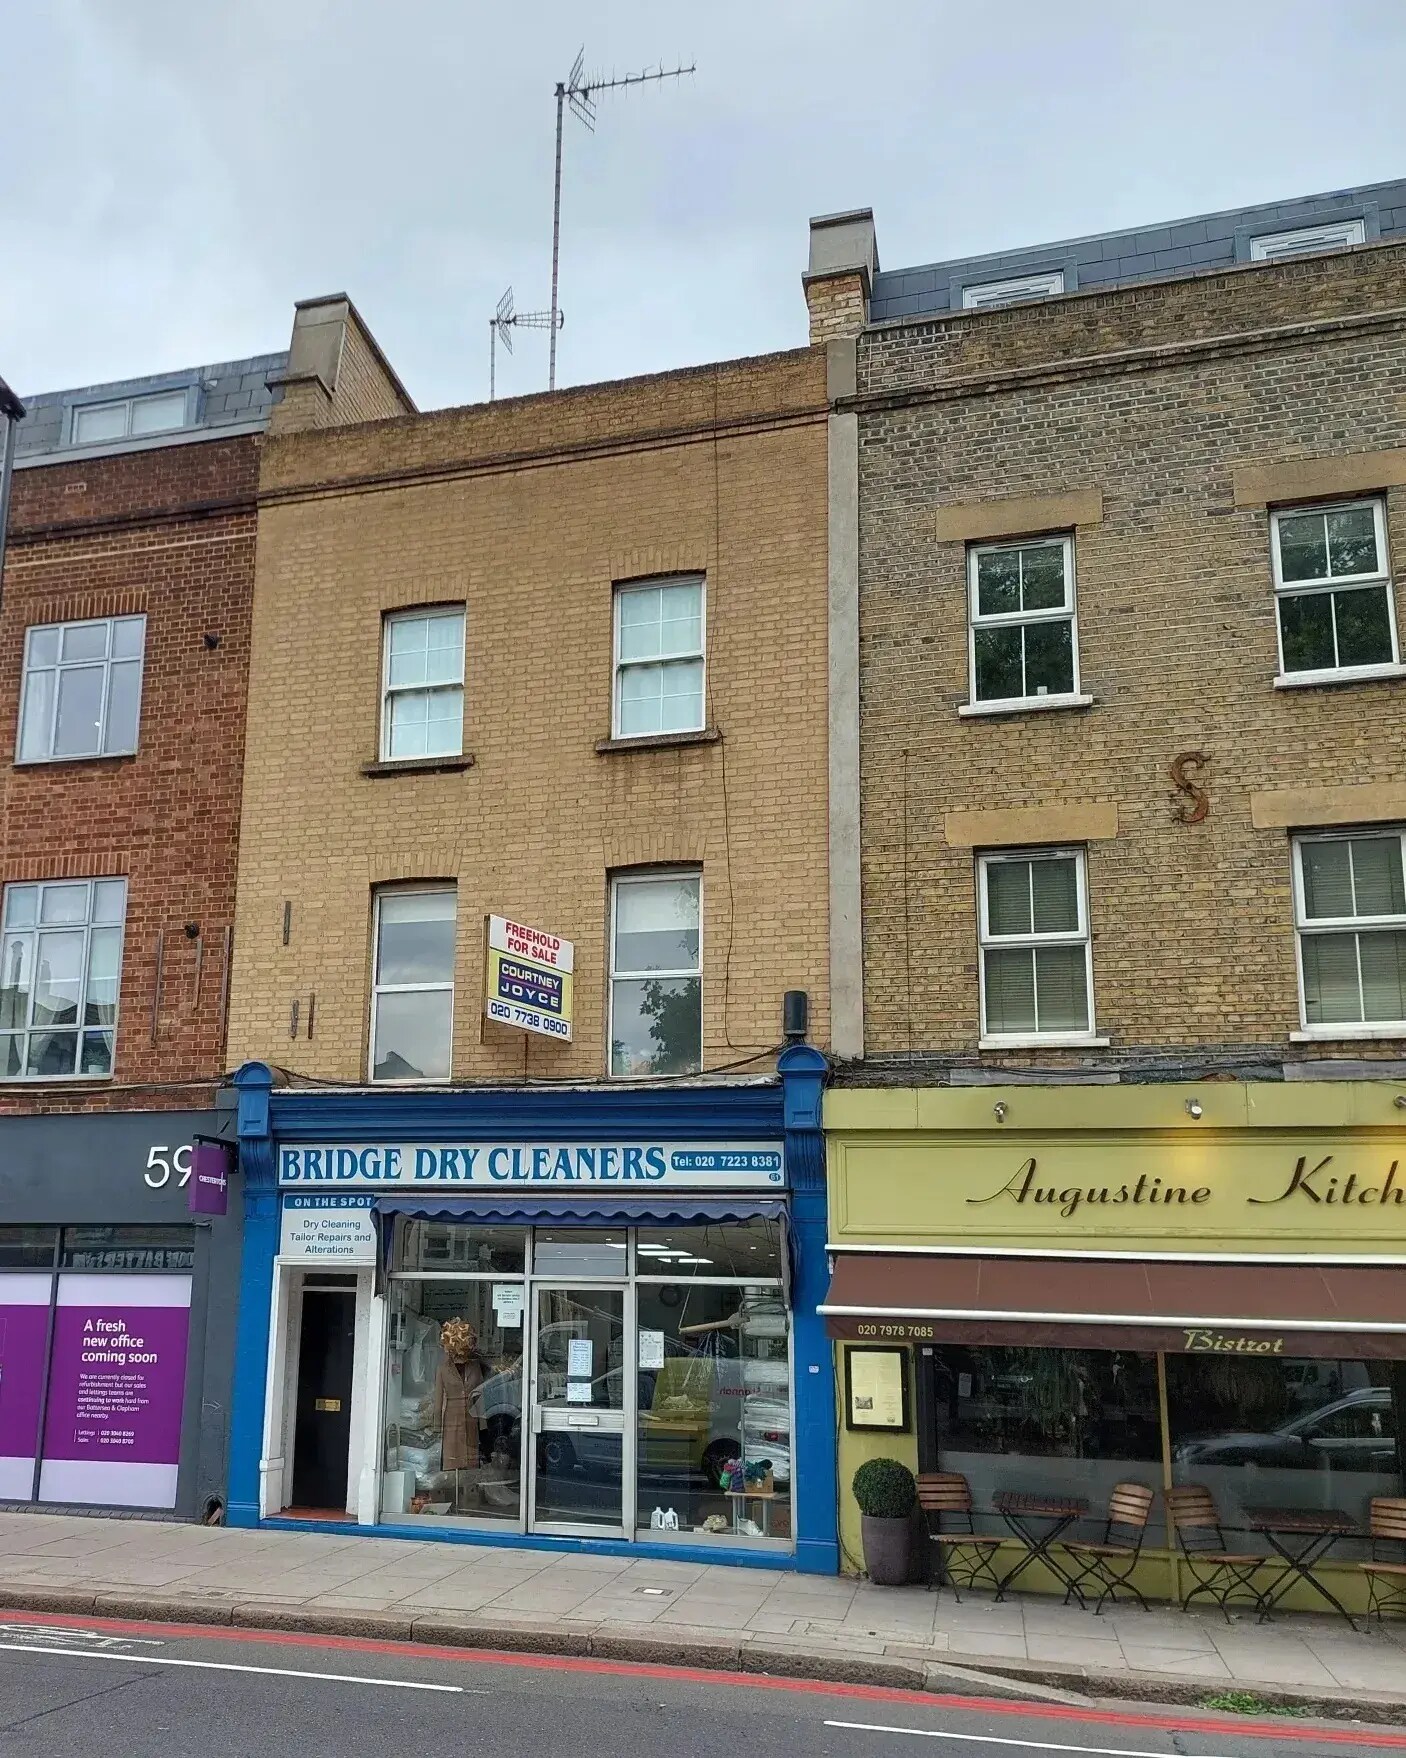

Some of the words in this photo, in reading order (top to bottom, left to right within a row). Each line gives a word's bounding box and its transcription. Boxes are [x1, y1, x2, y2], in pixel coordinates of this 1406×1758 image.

[505, 922, 560, 950] FREEHOLD
[507, 937, 529, 955] FOR
[532, 946, 557, 965] SALE
[501, 963, 559, 990] COURTNEY
[500, 982, 559, 1008] JOYCE
[491, 1003, 510, 1019] 020
[514, 1009, 540, 1028] 7738
[543, 1018, 568, 1036] 0900
[144, 1145, 193, 1188] 59
[281, 1148, 403, 1180] BRIDGE
[414, 1148, 481, 1180] DRY
[488, 1146, 667, 1180] CLEANERS
[672, 1156, 692, 1167] Tel:
[695, 1156, 715, 1167] 020
[720, 1156, 748, 1167] 7223
[751, 1155, 779, 1167] 8381
[965, 1157, 1212, 1218] Augustine
[1246, 1155, 1406, 1204] Kitch
[294, 1198, 311, 1207] ON
[314, 1197, 337, 1207] THE
[340, 1197, 372, 1207] SPOT
[303, 1219, 319, 1230] Dry
[321, 1219, 361, 1230] Cleaning
[290, 1232, 315, 1242] Tailor
[317, 1233, 352, 1243] Repairs
[354, 1233, 371, 1242] and
[304, 1245, 354, 1254] Alterations
[83, 1319, 93, 1332] A
[96, 1318, 126, 1332] fresh
[857, 1325, 877, 1335] 020
[879, 1325, 905, 1336] 7978
[907, 1326, 934, 1337] 7085
[82, 1337, 108, 1347] new
[110, 1334, 144, 1348] office
[1182, 1329, 1284, 1353] Bistrot
[81, 1350, 126, 1366] coming
[128, 1353, 157, 1363] soon
